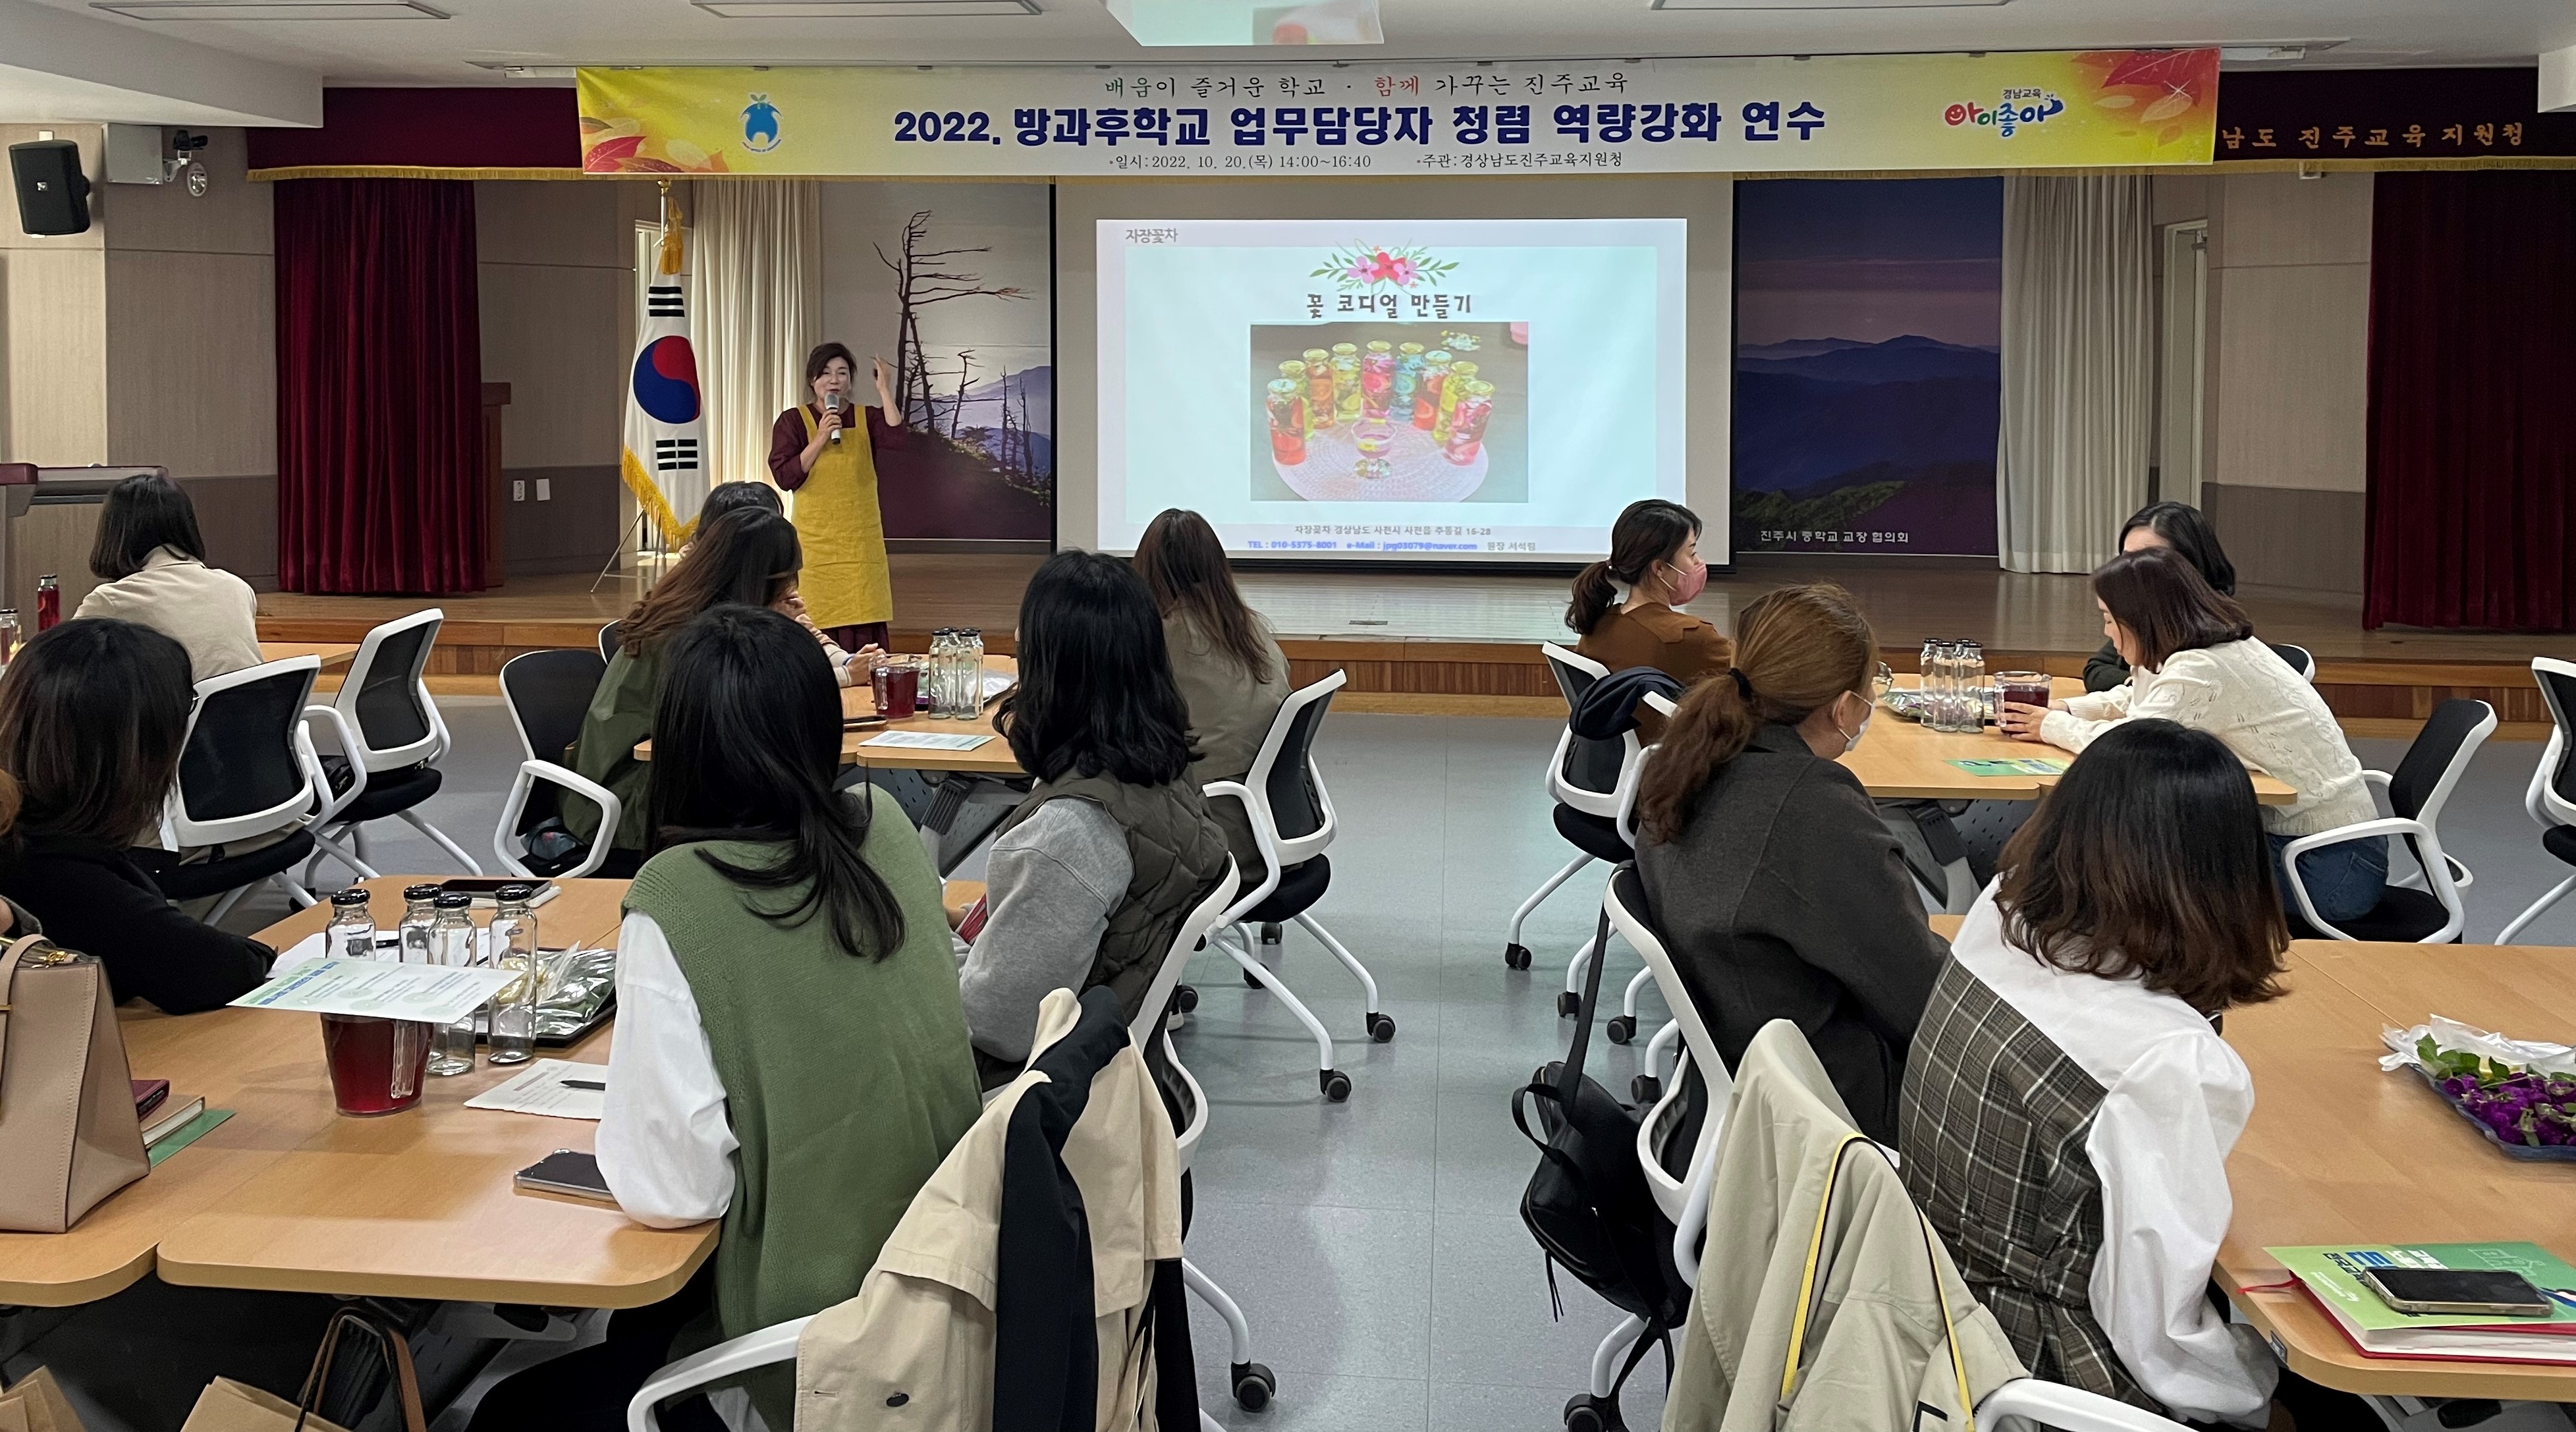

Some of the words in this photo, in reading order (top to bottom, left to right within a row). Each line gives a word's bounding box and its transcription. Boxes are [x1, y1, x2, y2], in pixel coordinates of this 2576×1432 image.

[1105, 76, 1176, 99] 배움이
[1190, 76, 1265, 99] 즐거운
[1278, 76, 1326, 97] 학교
[1374, 75, 1419, 97] 함께
[1435, 74, 1512, 96] 가꾸는
[1524, 72, 1628, 96] 진주교육
[2002, 88, 2042, 99] 경남교육
[894, 111, 1001, 146] 2022.
[1014, 107, 1210, 146] 방과후학교
[1230, 106, 1433, 146] 업무담당자
[1452, 105, 1530, 144] 청렴
[1553, 102, 1722, 144] 역량강화
[1742, 101, 1825, 142] 연수
[1944, 99, 2064, 138] 아이좋아
[2298, 122, 2524, 150] 진주교육지원청
[1197, 155, 1218, 170] 10.
[1224, 153, 1273, 170] 20.(목)
[1279, 155, 1371, 169] 14:00~16:40
[1125, 227, 1178, 244] 자장꽃차
[1307, 293, 1324, 319] 꽃
[1337, 294, 1398, 319] 코디얼
[1411, 294, 1471, 319] 만들기
[1334, 525, 1371, 535] 경상남도
[1374, 526, 1400, 535] 사천시
[1760, 530, 1797, 542] 진주시
[1801, 530, 1838, 543] 중학교
[1843, 531, 1868, 543] 교장
[1871, 532, 1909, 544] 협의회
[1487, 541, 1504, 551] 원장
